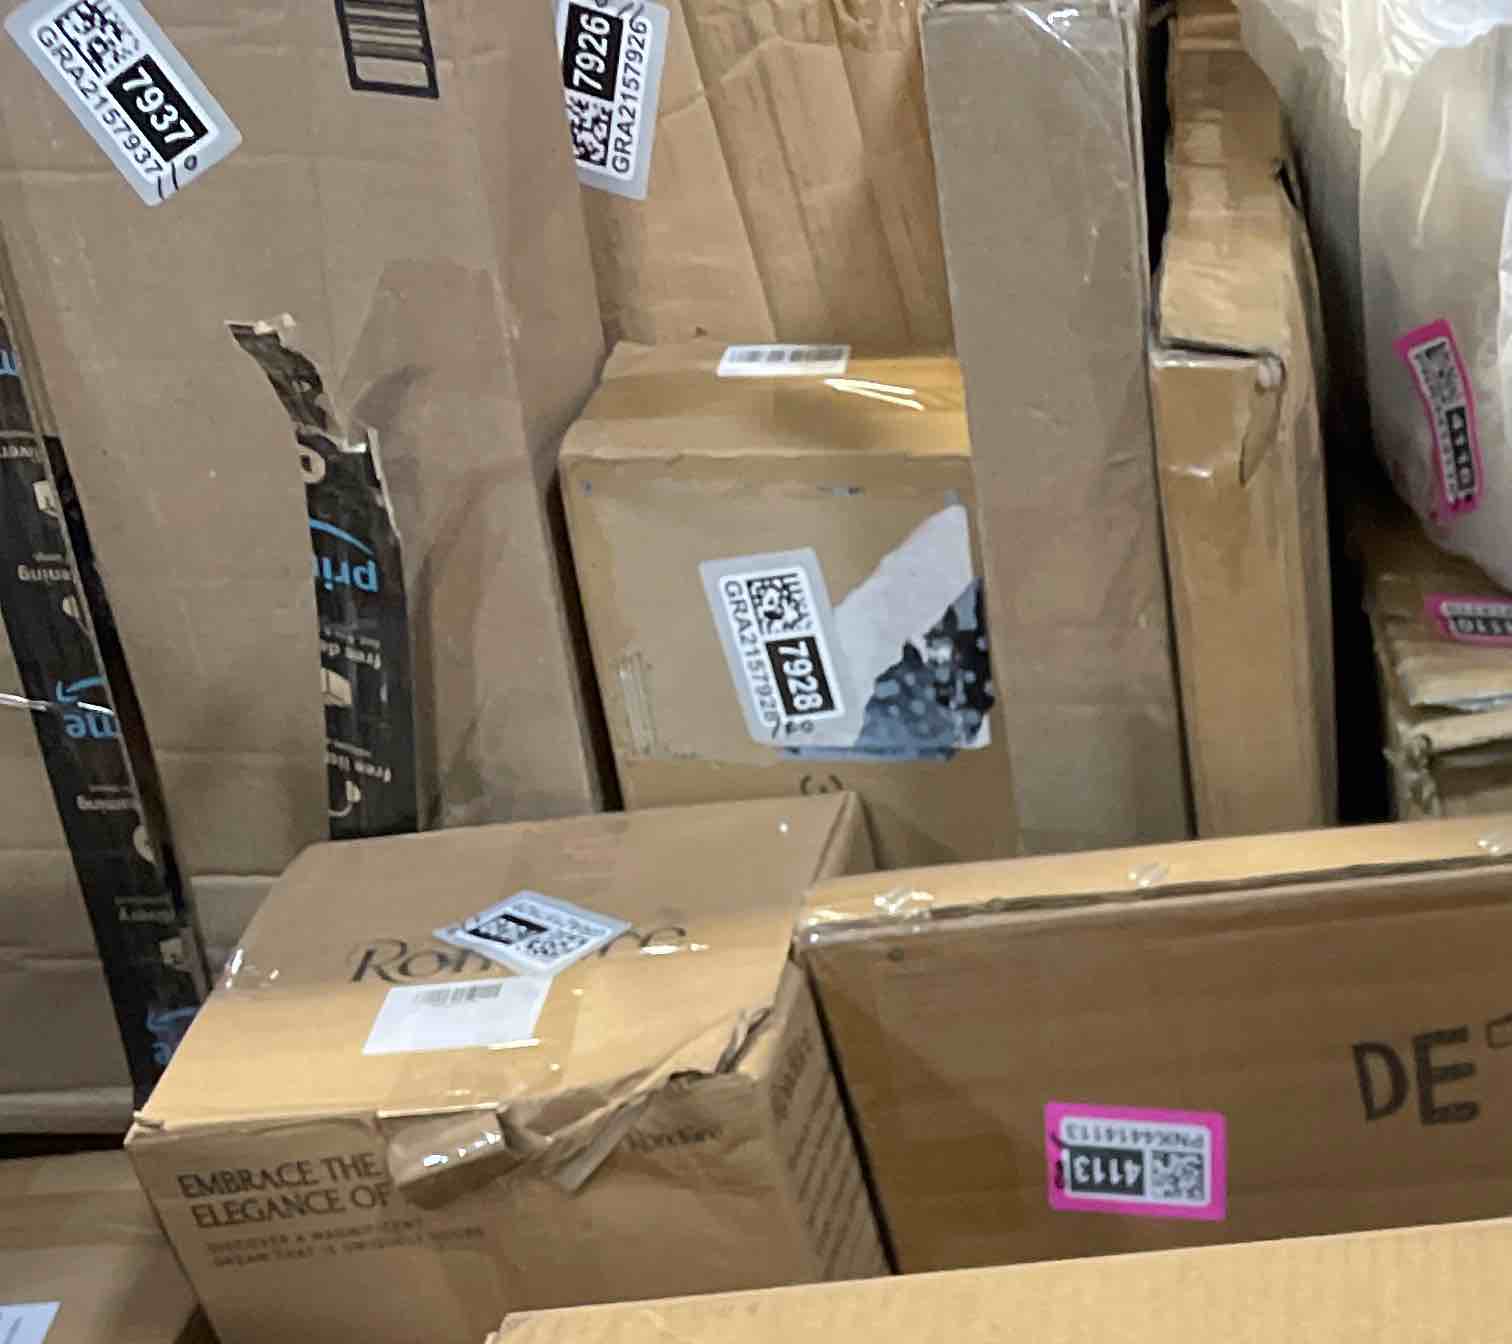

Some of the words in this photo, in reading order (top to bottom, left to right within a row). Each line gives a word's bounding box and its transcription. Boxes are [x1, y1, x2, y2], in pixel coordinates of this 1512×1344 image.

[572, 13, 612, 92] 7926
[36, 25, 164, 174] GRA2157937
[122, 66, 195, 144] 7937
[611, 16, 649, 174] GRA2157926
[778, 639, 824, 712] 7928
[177, 1159, 320, 1199] EMBRACE
[320, 1151, 386, 1182] THE
[190, 1187, 348, 1230] ELEGANCE
[1072, 1154, 1141, 1188] 4113
